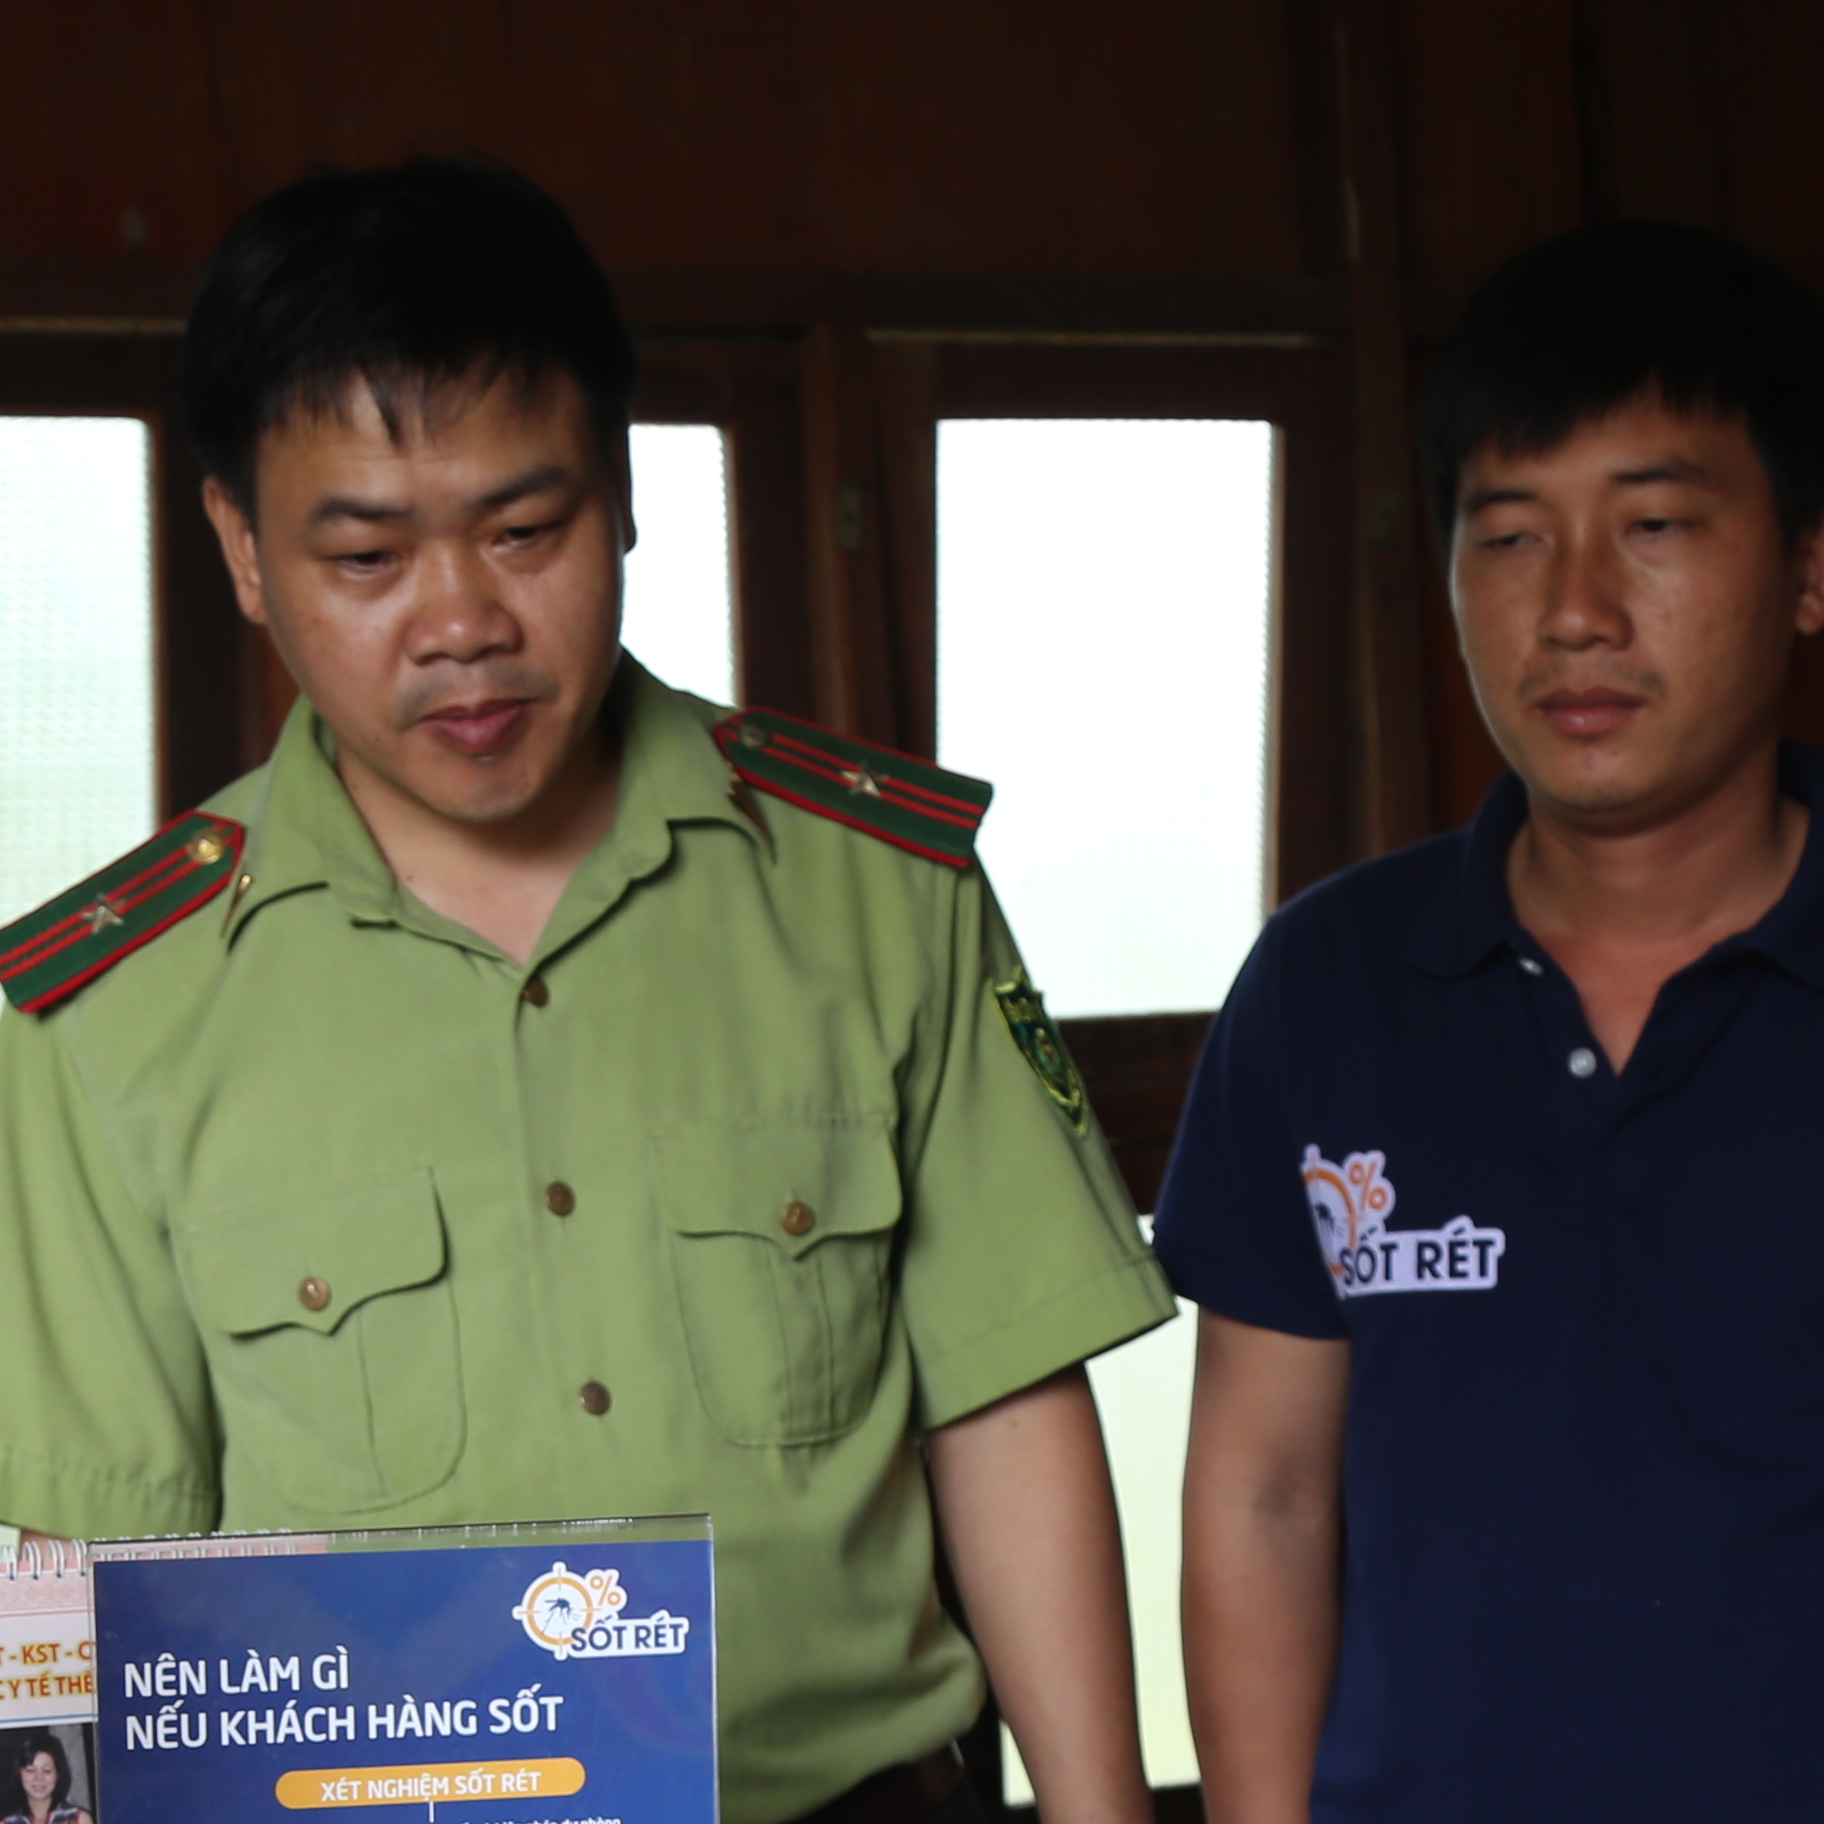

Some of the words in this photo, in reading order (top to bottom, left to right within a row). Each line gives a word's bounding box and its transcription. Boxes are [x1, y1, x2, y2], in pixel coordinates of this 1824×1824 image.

[1339, 1225, 1399, 1286] SỐT
[1416, 1226, 1495, 1280] RÉT
[570, 1618, 629, 1652] SỐT
[634, 1612, 683, 1650] RÉT
[22, 1642, 61, 1665] KST
[78, 1640, 97, 1661] C
[124, 1652, 207, 1698] NÊN
[219, 1649, 300, 1694] LÀM
[312, 1645, 349, 1690] GÌ
[5, 1678, 21, 1699] Y
[25, 1670, 51, 1697] TẾ
[126, 1699, 207, 1750] NẾU
[220, 1699, 355, 1746] KHÁCH
[368, 1694, 477, 1739] HÀNG
[488, 1683, 564, 1734] SỐT
[320, 1776, 363, 1802] XÉT
[366, 1772, 450, 1802] NGHIỆM
[454, 1767, 496, 1796] SỐT
[500, 1768, 542, 1793] RÉT
